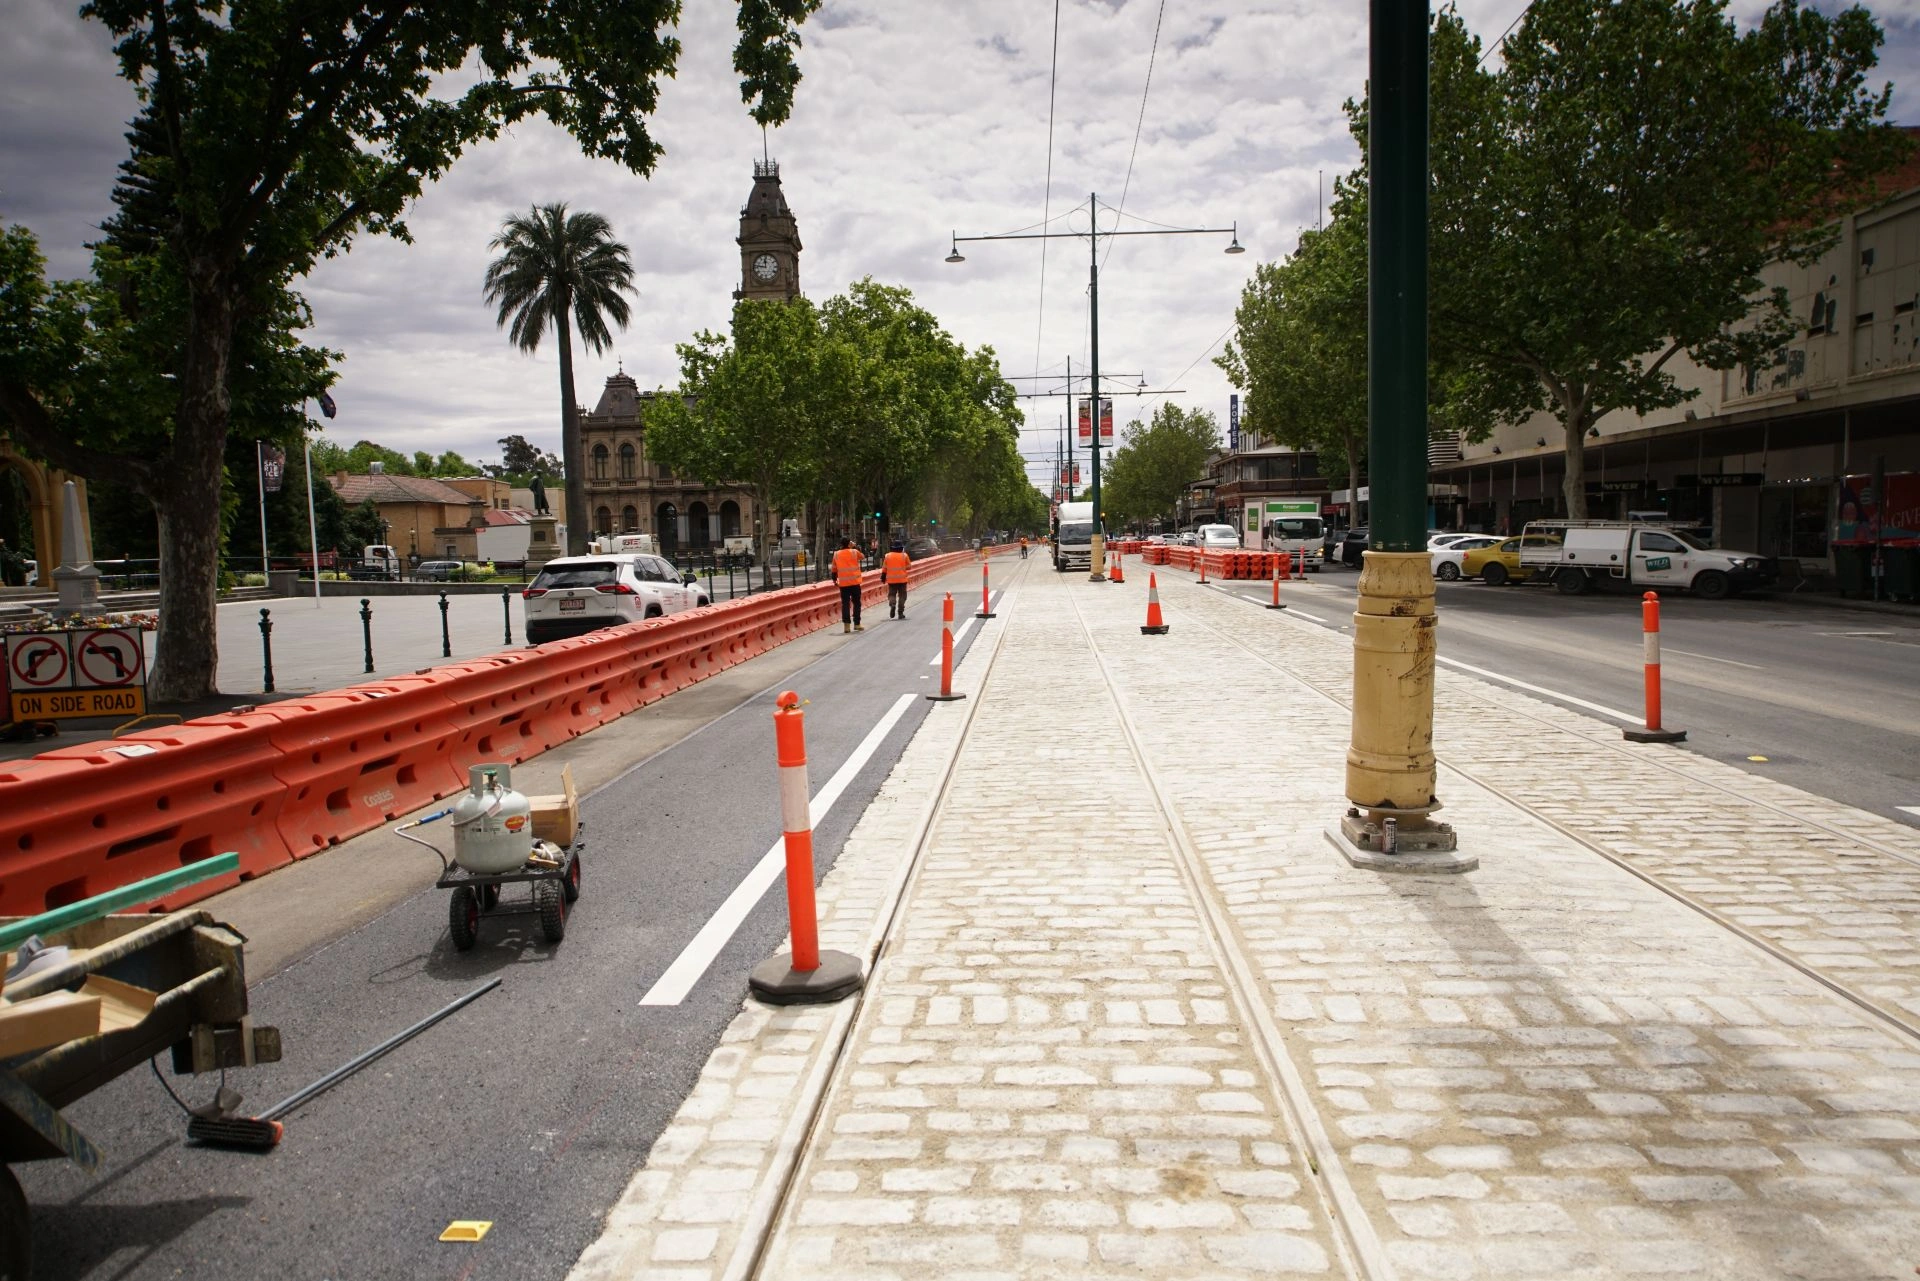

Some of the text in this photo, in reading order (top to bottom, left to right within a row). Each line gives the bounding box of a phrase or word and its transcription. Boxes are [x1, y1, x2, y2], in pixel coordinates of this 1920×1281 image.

[1603, 482, 1639, 490] MYER
[1701, 476, 1742, 485] MYER
[20, 693, 136, 714] ON SIDE ROAD
[364, 790, 394, 807] Coates
